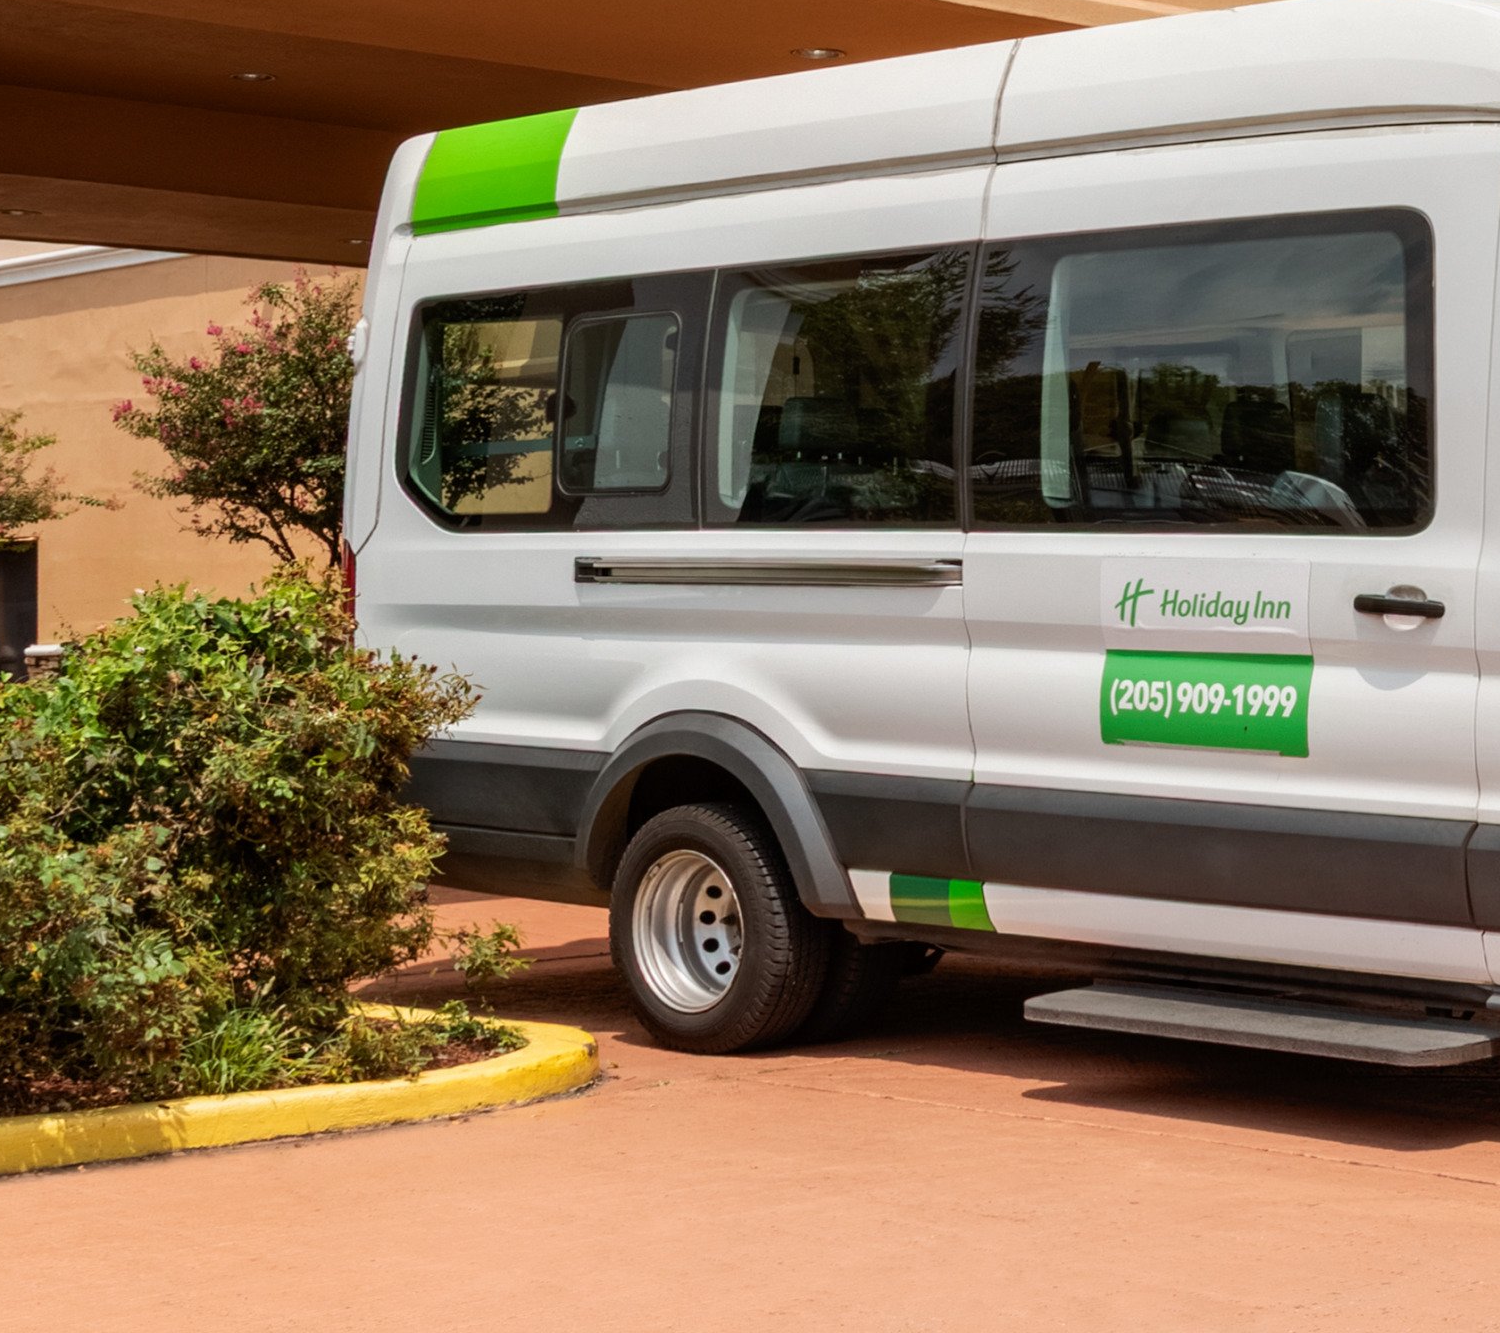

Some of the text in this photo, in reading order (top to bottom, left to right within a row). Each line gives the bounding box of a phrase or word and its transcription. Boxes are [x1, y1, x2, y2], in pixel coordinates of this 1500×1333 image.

[1160, 589, 1250, 626] Holiday
[1253, 590, 1291, 620] Inn
[1110, 678, 1298, 719] (205) 909-1999
